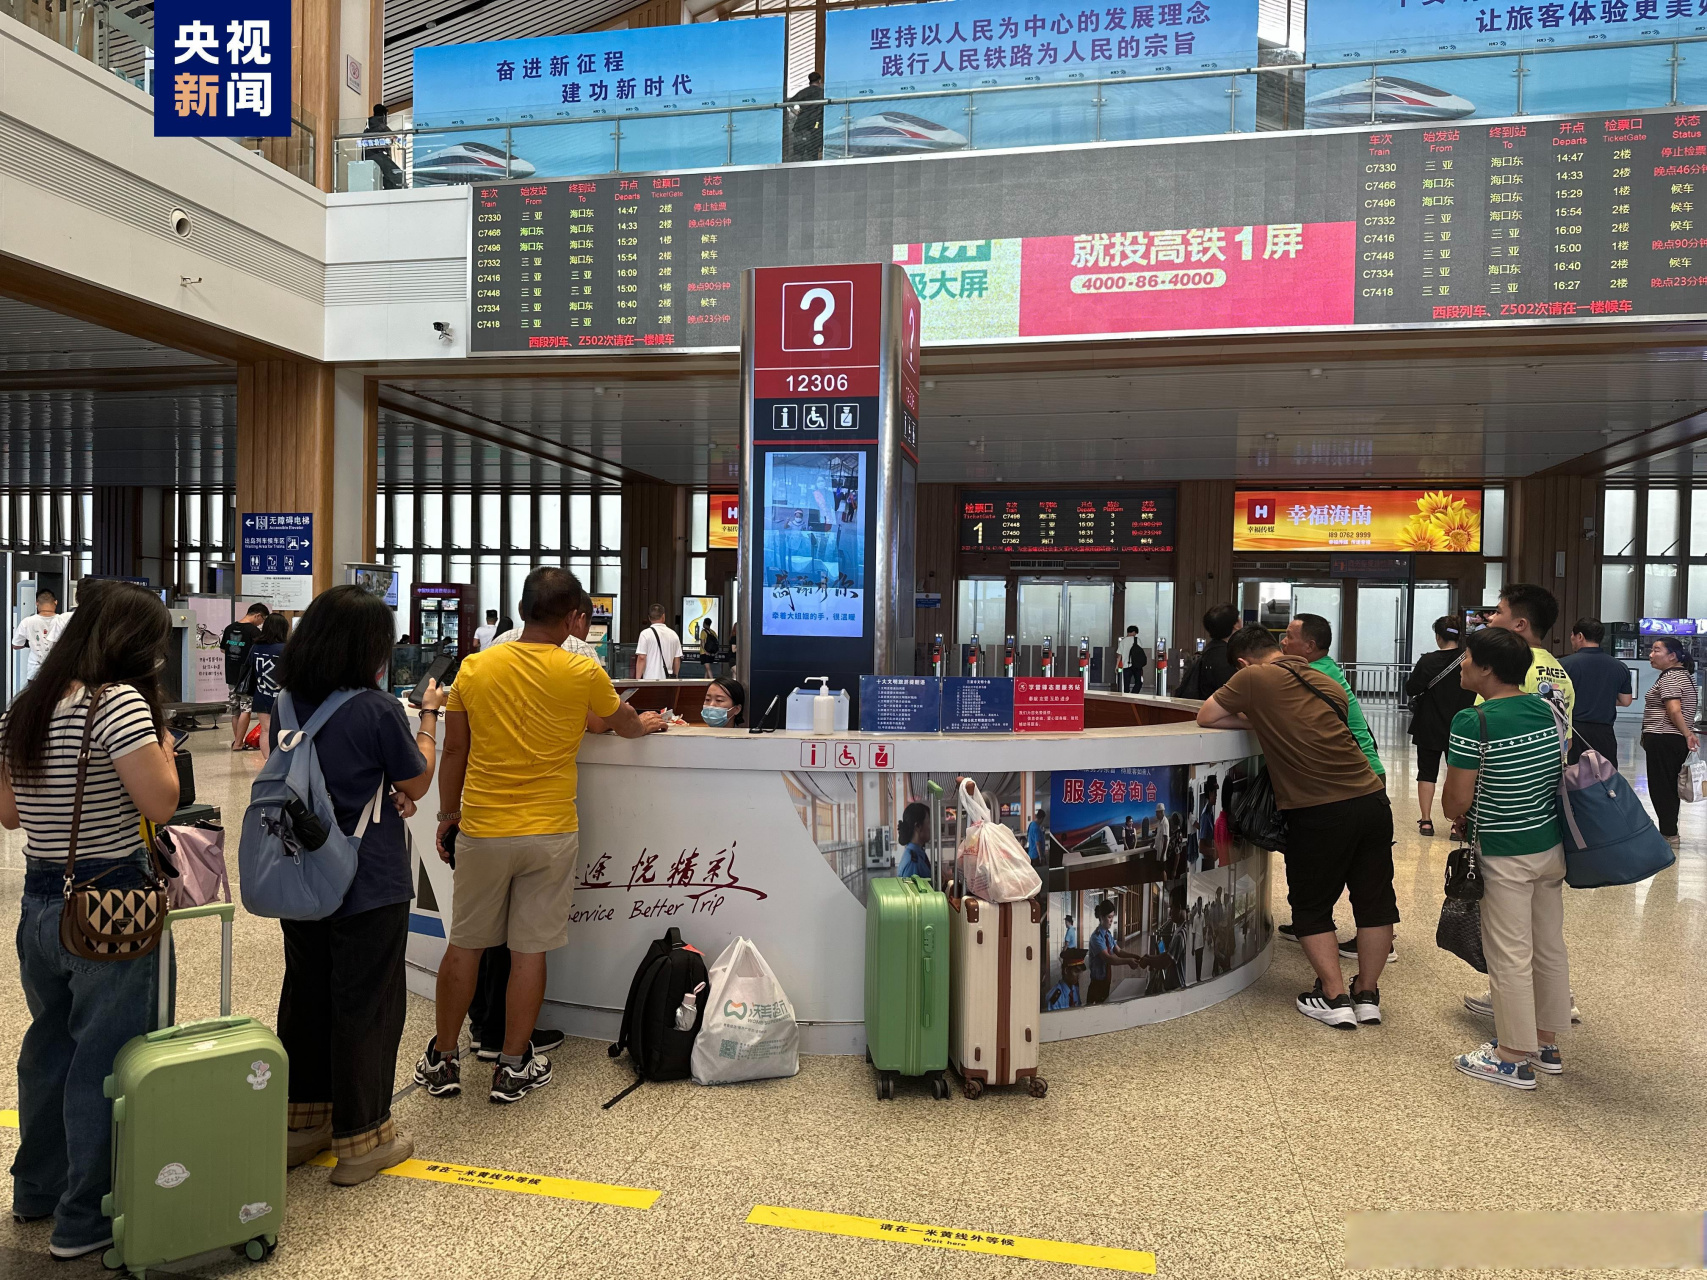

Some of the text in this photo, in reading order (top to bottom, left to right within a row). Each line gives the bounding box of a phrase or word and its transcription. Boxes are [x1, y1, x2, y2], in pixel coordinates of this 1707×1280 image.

[870, 0, 1211, 50] 坚持以人民为中心的发展理念
[881, 31, 1198, 77] 践行人民铁路为人民的宗旨
[496, 50, 624, 82] 奋进新征程
[561, 73, 693, 104] 建功新时代
[1367, 115, 1700, 145] 车次 始发站 终到站 开点 检票口 状态
[1428, 144, 1452, 152] From
[1366, 146, 1706, 172] C7330 海口东 14:47 2楼 停止检票
[481, 176, 722, 198] 车次 始发站 终到站 开点 检票口 状态
[1365, 181, 1396, 190] C7466
[1423, 179, 1454, 188] 海口东
[1491, 175, 1523, 185] 海口东
[1557, 171, 1583, 180] 14:33
[1613, 168, 1631, 177] 2楼
[1365, 184, 1694, 207] C7496 海口东 海口东 15:29 1楼 候车
[570, 209, 594, 218] 海口东
[1365, 202, 1693, 225] C7332 海口东 15:54 2楼 候车
[520, 227, 544, 236] 海口东
[570, 225, 594, 233] 海口东
[1364, 221, 1693, 243] C7416 16:09 2楼 候车
[520, 243, 543, 251] 海口东
[570, 240, 593, 249] 海口东
[1071, 224, 1303, 268] 就投高铁1屏
[1364, 252, 1394, 260] C7448
[1555, 244, 1581, 252] 15:00
[1612, 241, 1629, 250] 1楼
[478, 259, 500, 267] C7332
[570, 255, 593, 264] 海口东
[1363, 258, 1691, 278] C7334 海口东 16:40 2楼 候车
[1082, 271, 1215, 291] 4000-86-4000
[1363, 288, 1393, 296] C7418
[1554, 281, 1580, 289] 16:27
[1611, 279, 1628, 288] 2楼
[569, 302, 593, 310] 海口东
[1433, 300, 1635, 319] 西段列车、Z502次请在一楼候车
[786, 374, 848, 392] 12306
[965, 503, 993, 513] 检票口
[1286, 504, 1372, 525] 幸福海南
[269, 516, 310, 525] 无障碍电梯
[244, 537, 285, 545] 出岛列车候车区
[1062, 779, 1158, 804] 服务咨询台
[575, 841, 742, 893] 途悦精彩
[629, 898, 684, 919] Better
[691, 893, 725, 916] Trip
[425, 1164, 542, 1187] 请在一米黄线外等候
[879, 1222, 1016, 1248] 请在一米黄线外等候
[922, 1237, 967, 1248] Wait here
